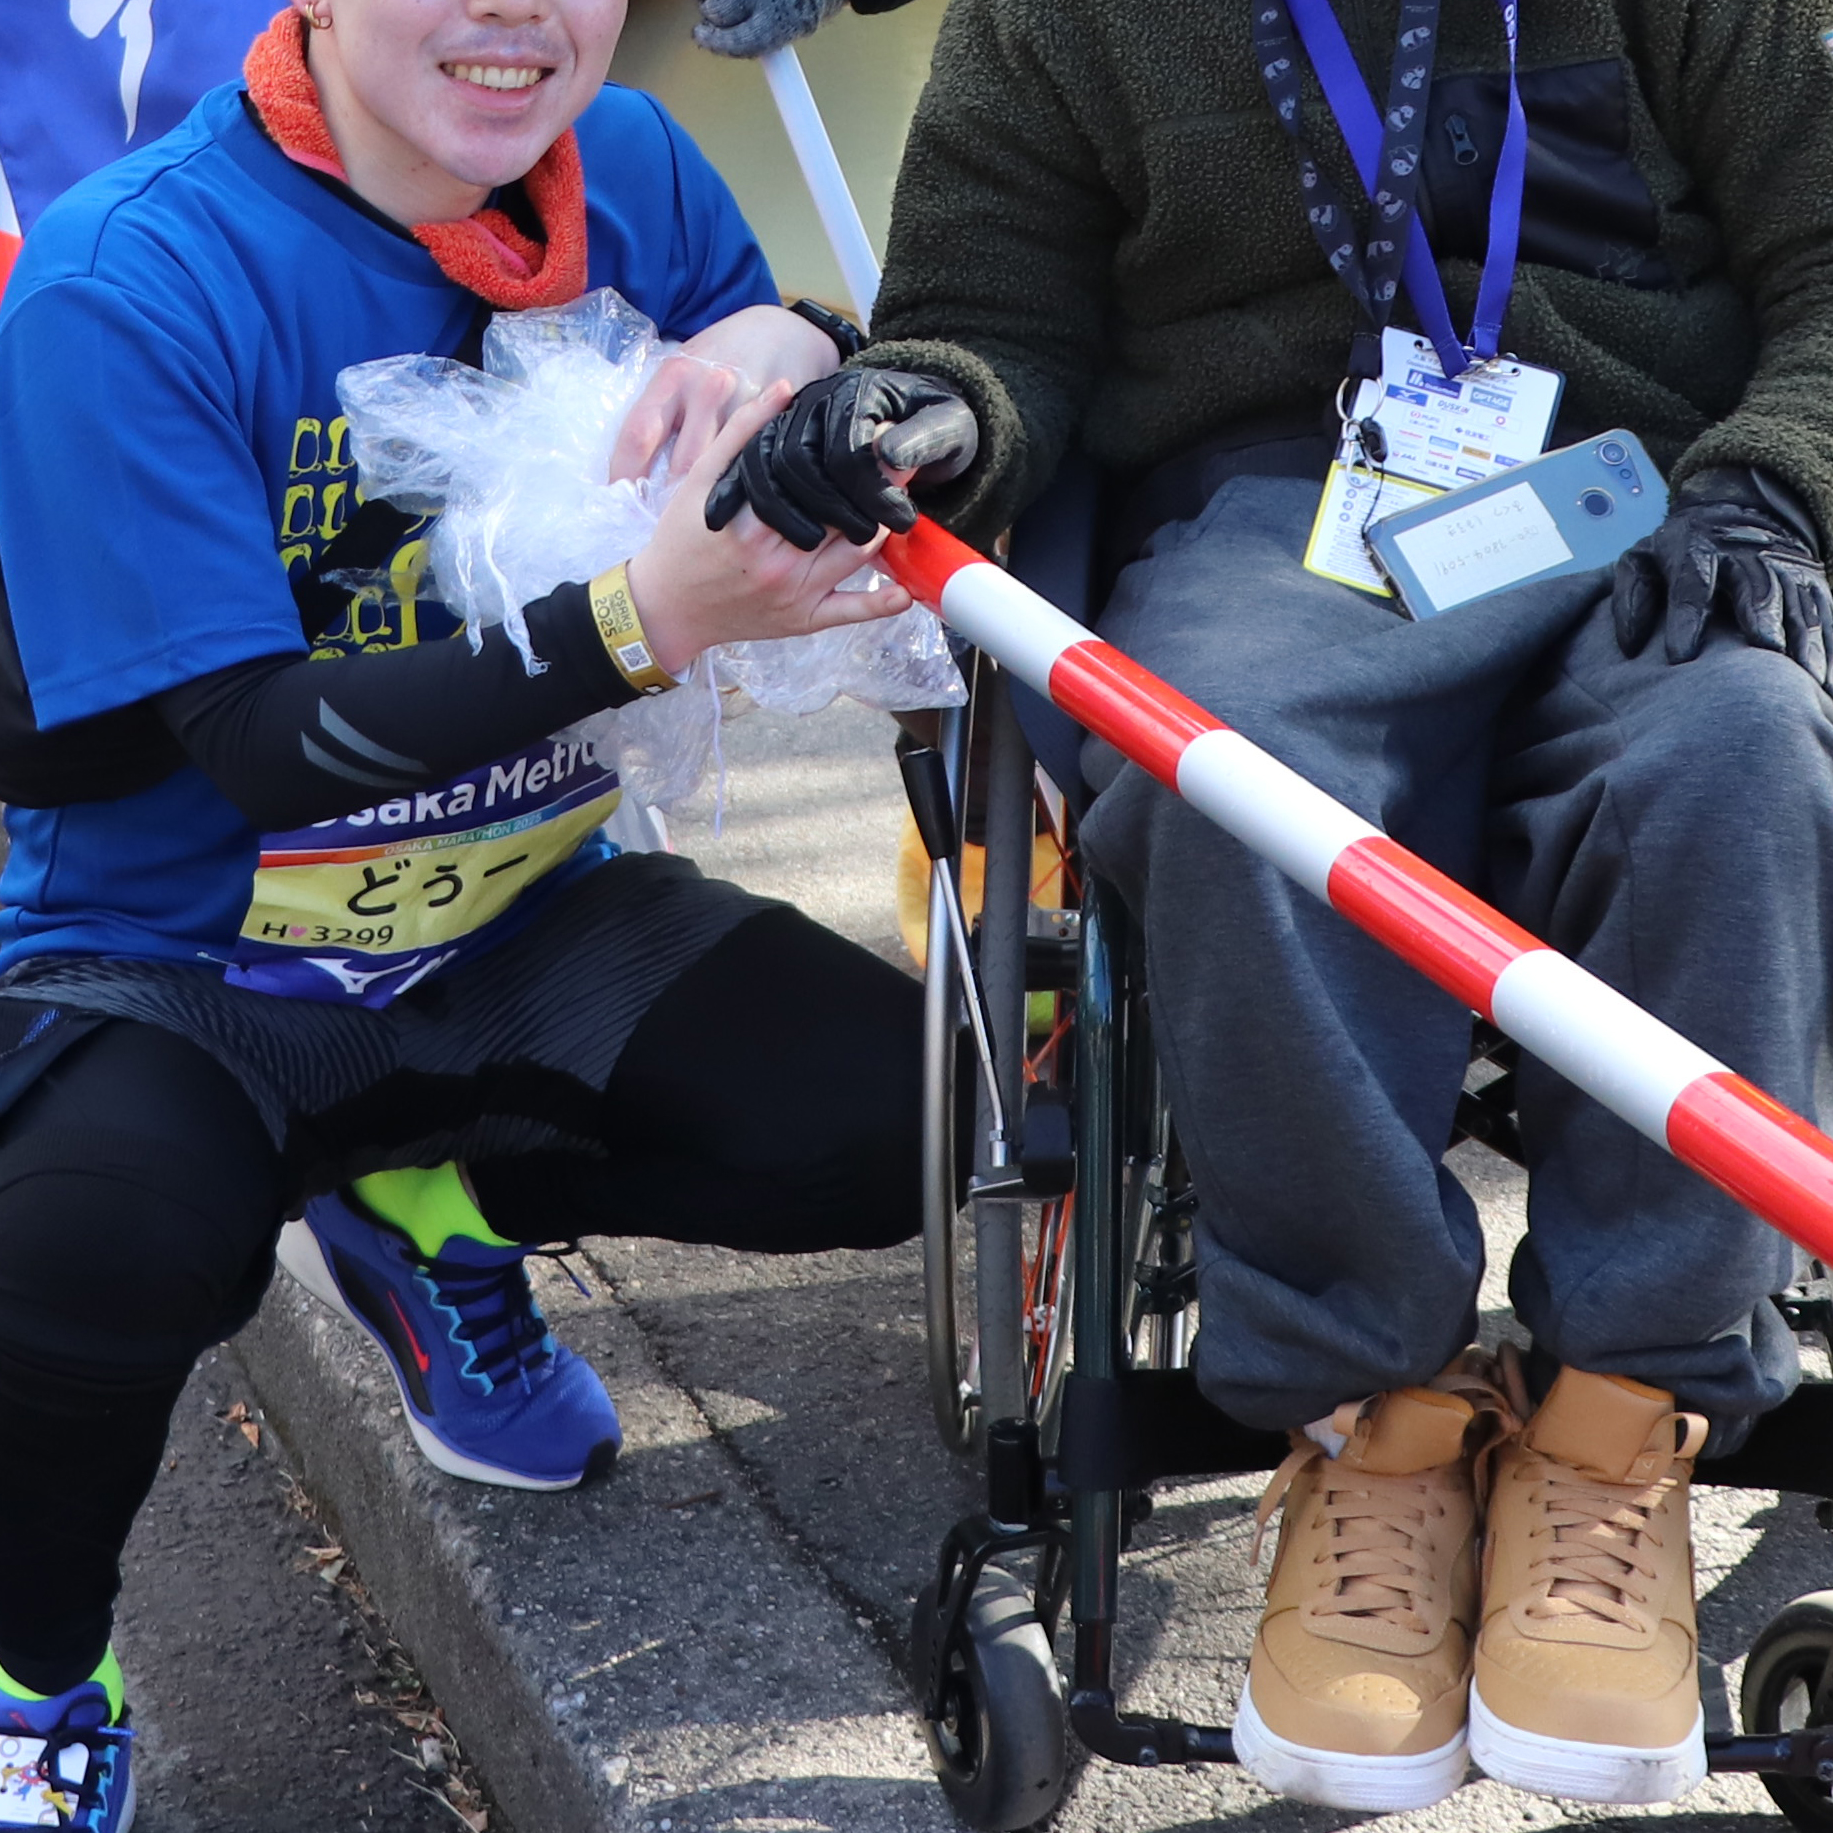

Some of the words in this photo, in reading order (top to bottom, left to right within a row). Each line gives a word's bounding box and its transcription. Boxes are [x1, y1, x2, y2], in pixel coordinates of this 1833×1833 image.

[594, 597, 618, 638] 2025
[614, 589, 634, 631] OSAKA
[311, 782, 477, 828] saka
[384, 839, 433, 856] OSAKA
[435, 823, 511, 848] MARATHON
[513, 813, 542, 833] 2025
[347, 858, 529, 916] どうー
